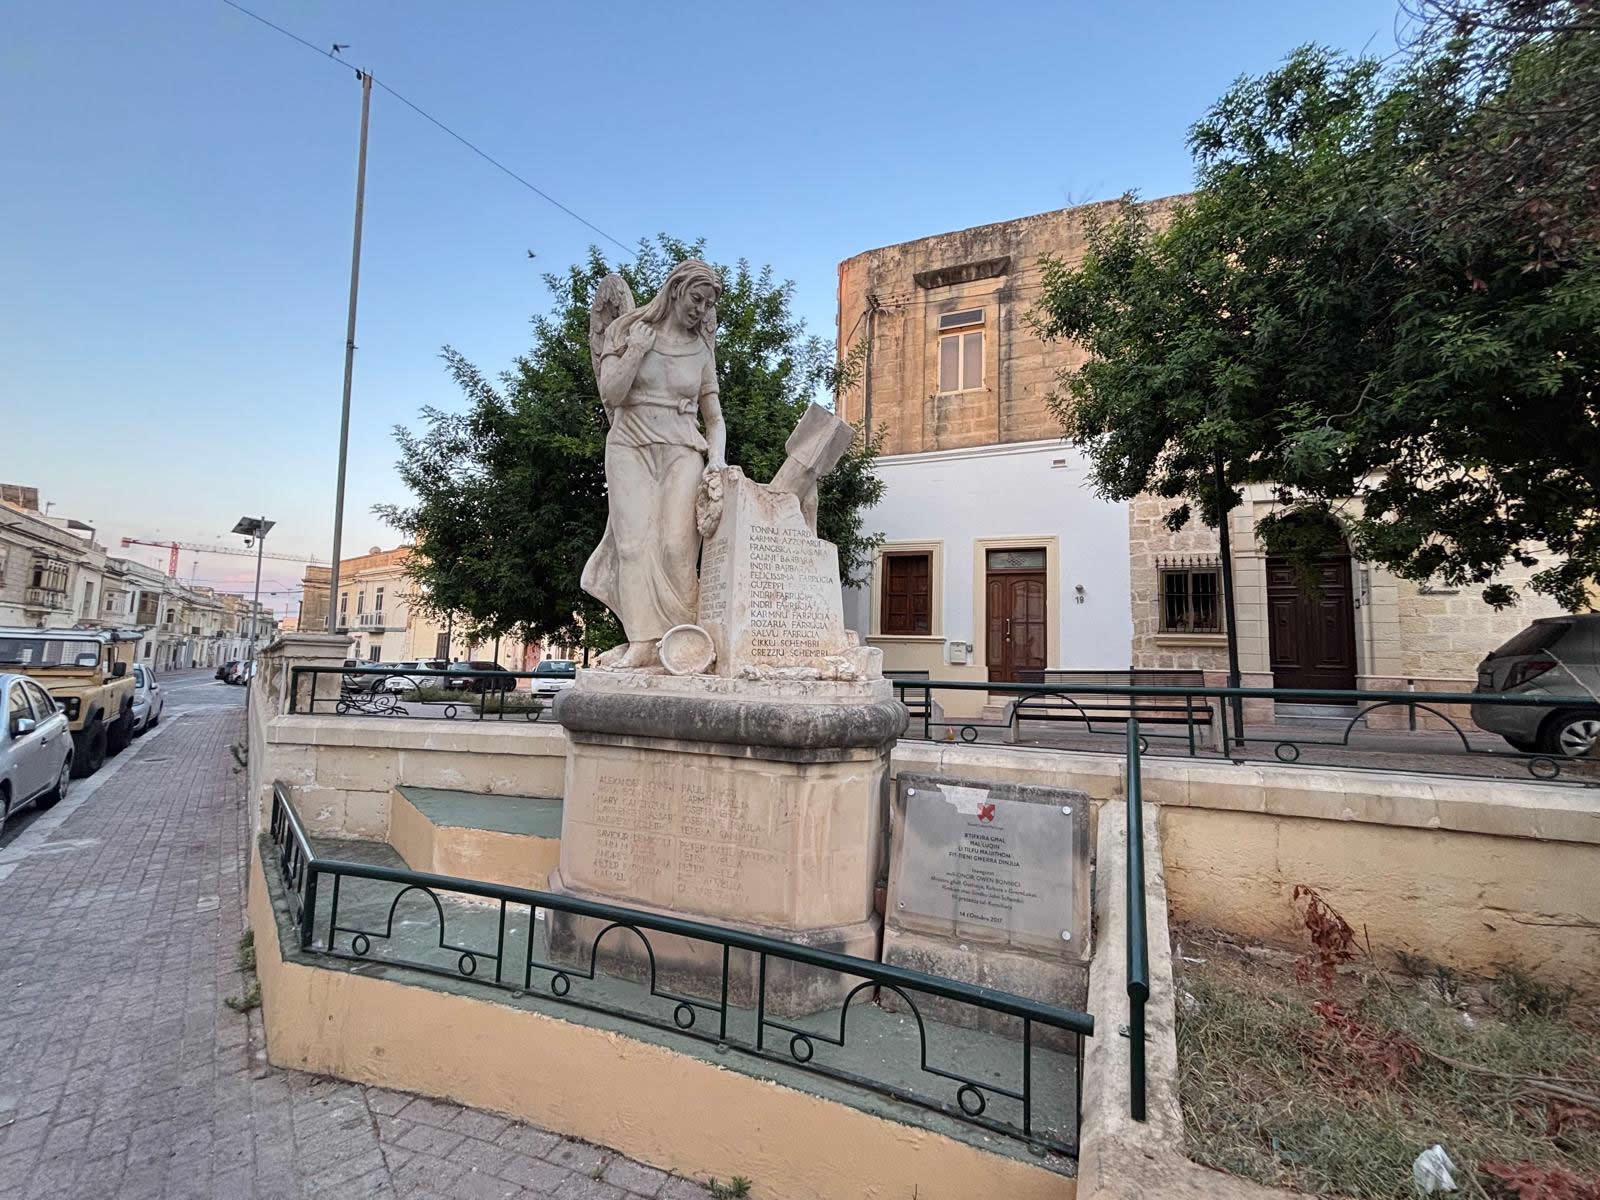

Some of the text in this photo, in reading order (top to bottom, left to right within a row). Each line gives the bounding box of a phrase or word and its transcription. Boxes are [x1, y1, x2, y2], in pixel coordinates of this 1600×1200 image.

[750, 600, 773, 609] INDRI
[1075, 595, 1085, 605] 19
[780, 639, 820, 648] SCHEMBRI
[790, 649, 829, 658] SCHEMBRI
